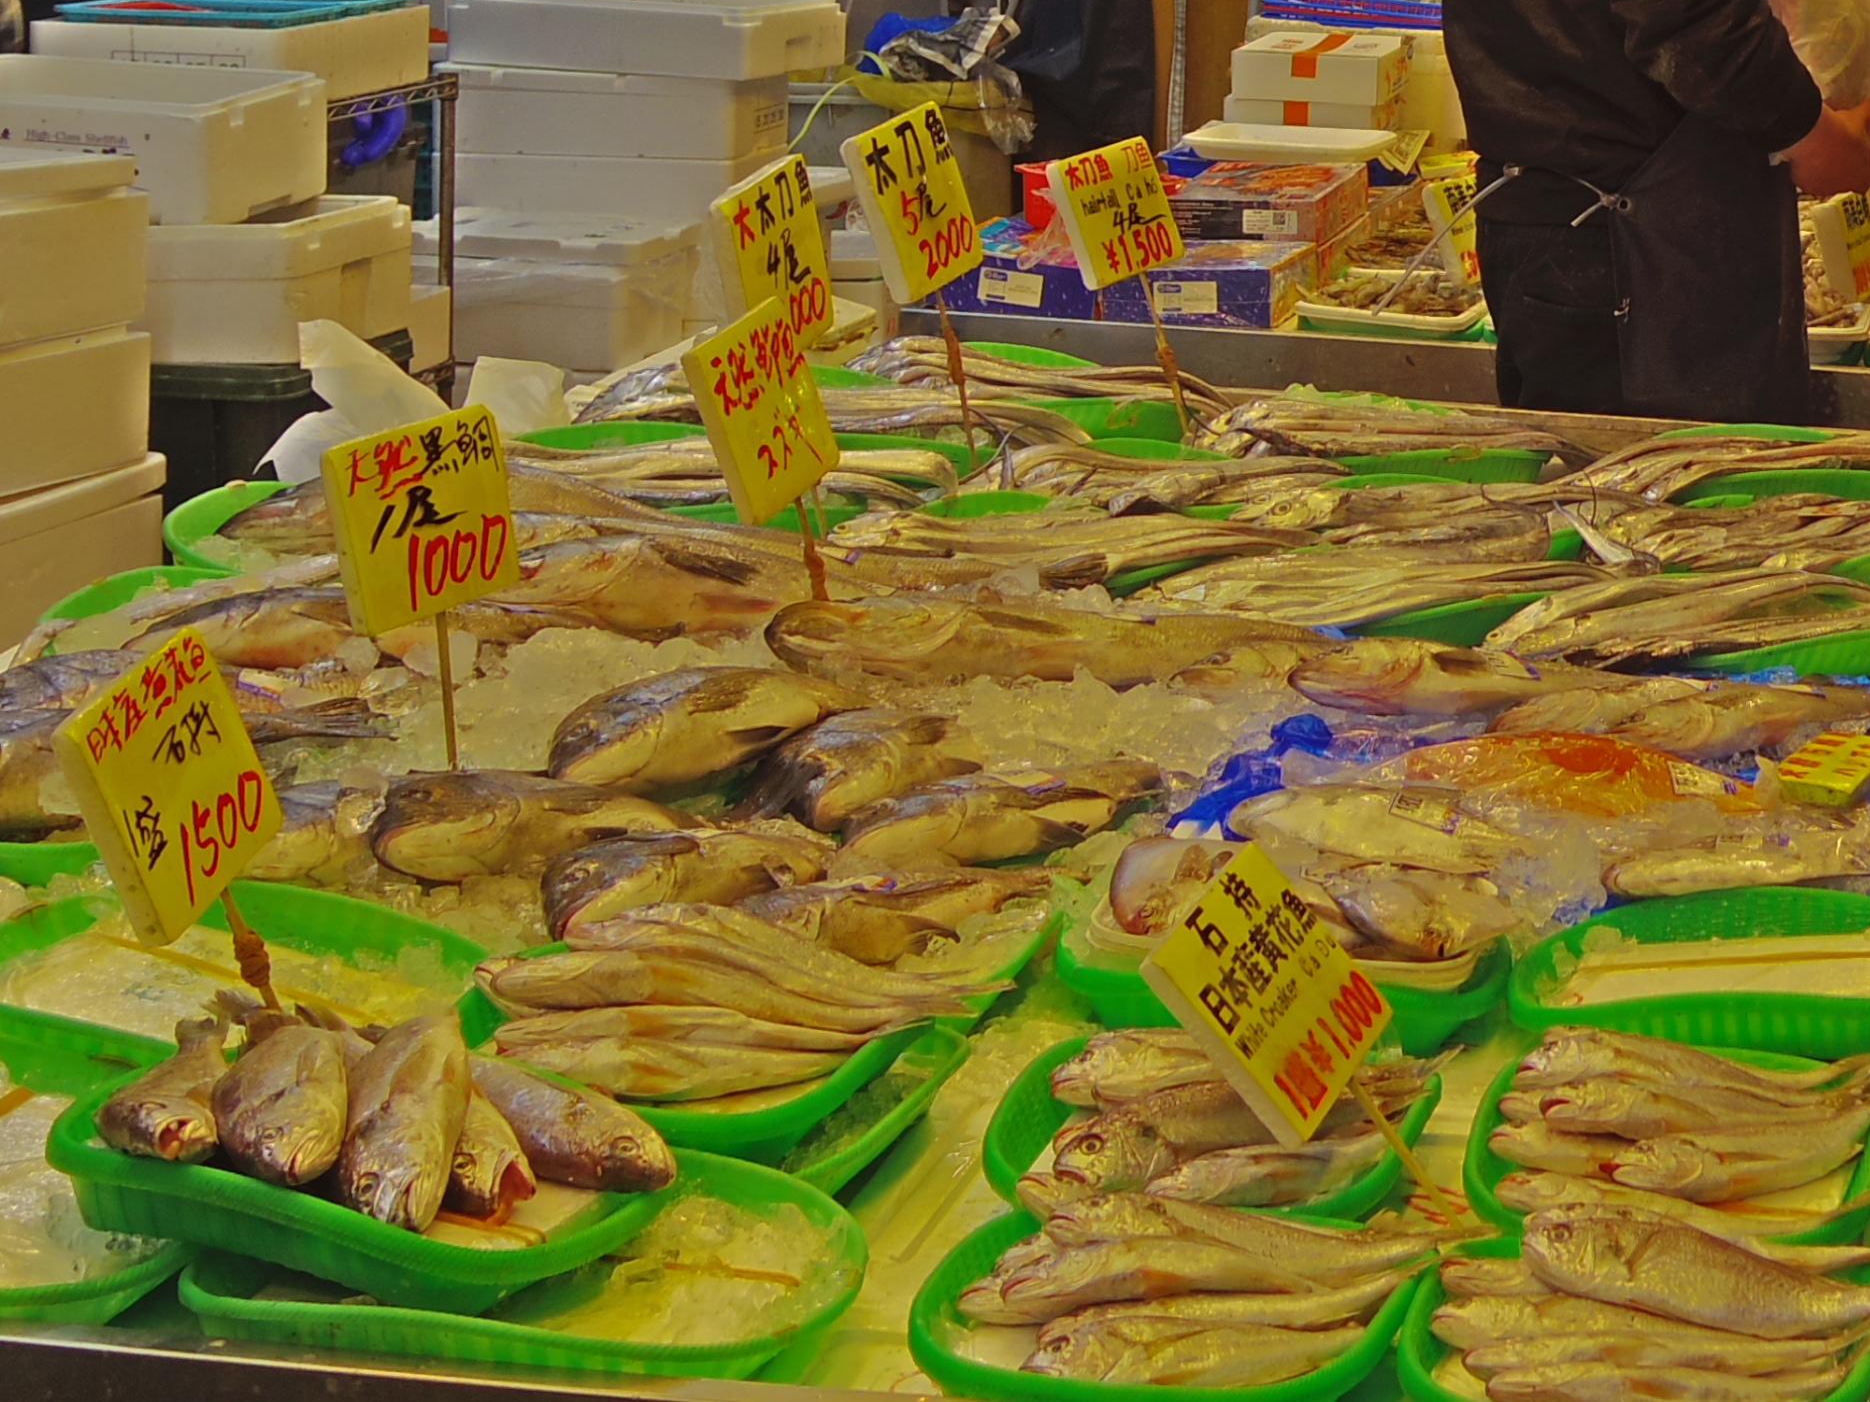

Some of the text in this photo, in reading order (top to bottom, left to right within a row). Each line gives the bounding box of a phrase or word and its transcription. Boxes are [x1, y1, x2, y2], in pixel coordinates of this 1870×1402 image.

[866, 108, 955, 196] 太刀魚
[1065, 153, 1113, 191] 太刀魚
[919, 213, 974, 280] 2000
[1101, 221, 1174, 274] ¥1,500
[409, 514, 507, 612] 1000
[180, 770, 262, 907] 1500
[1198, 888, 1318, 1036] 日本産黄花魚
[1235, 1021, 1268, 1061] White
[1259, 978, 1298, 1026] Croaker
[1299, 969, 1383, 1074] ¥1,000
